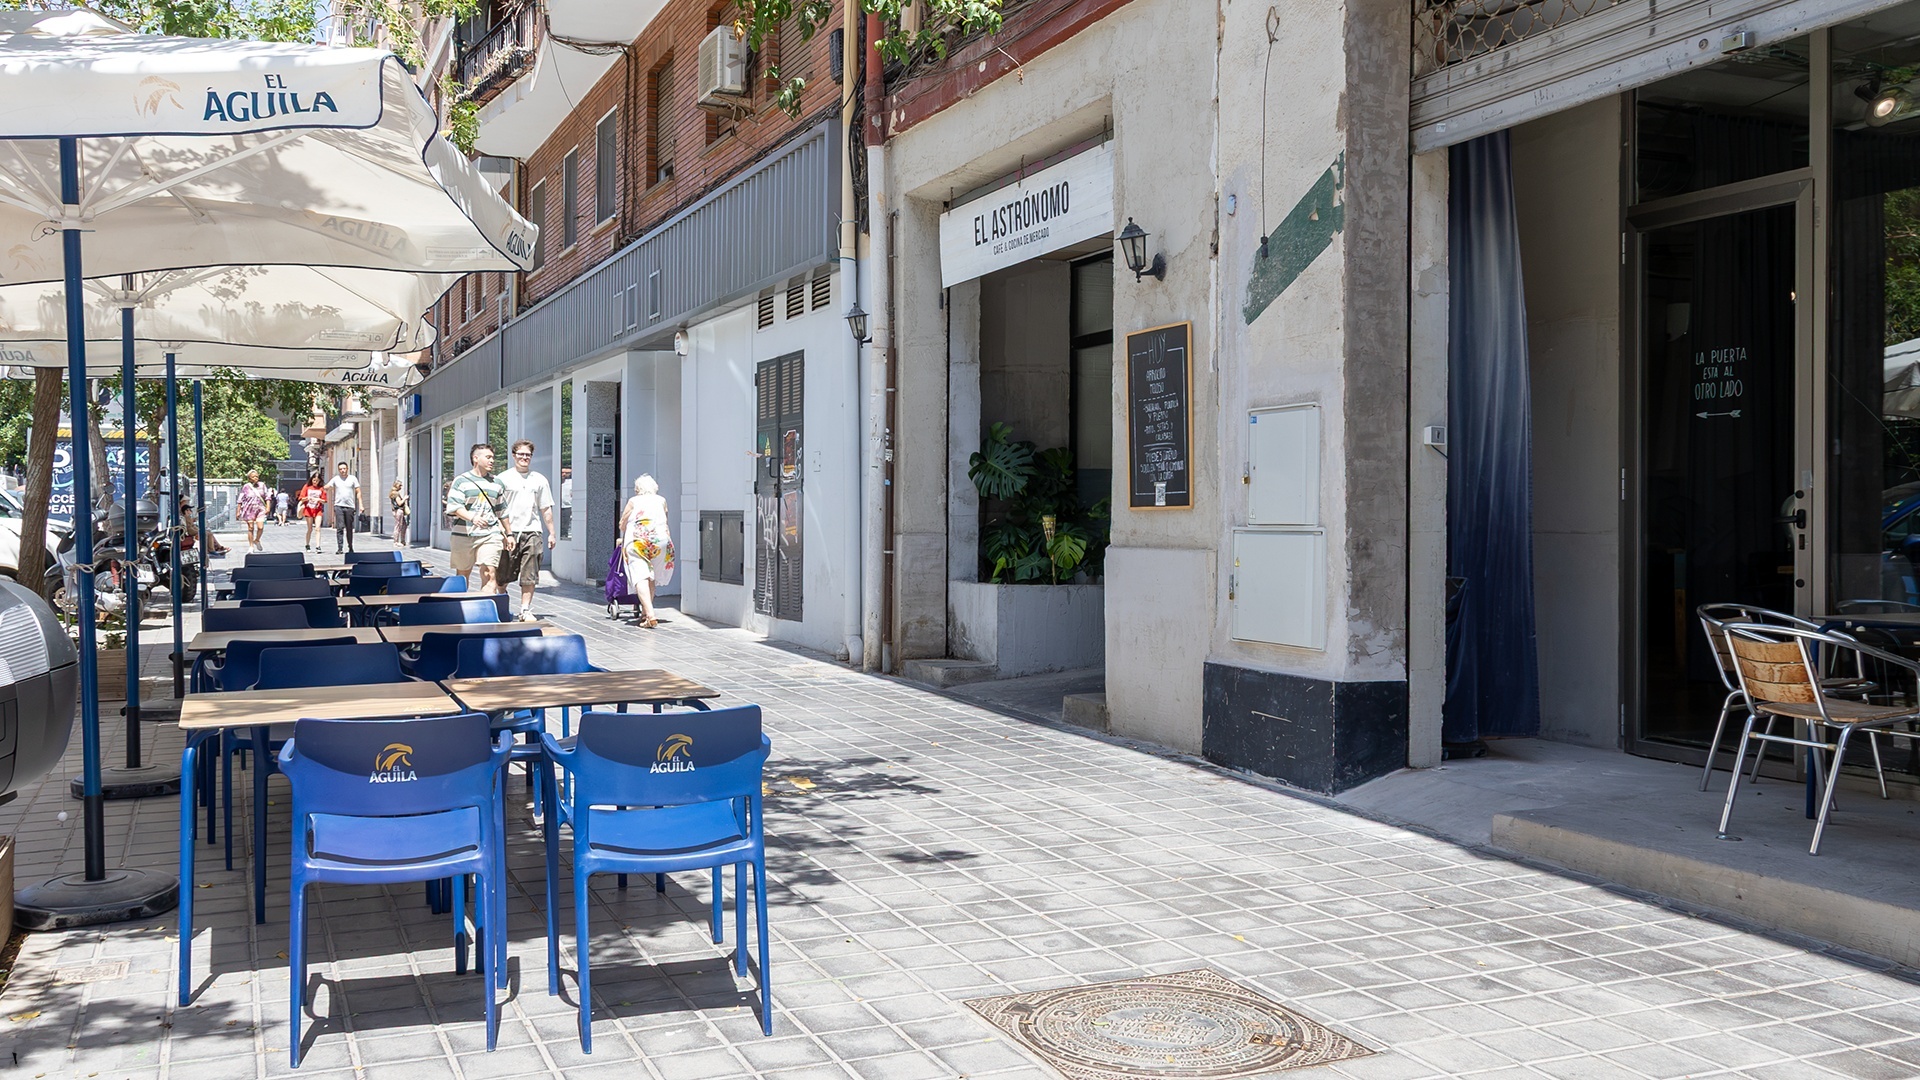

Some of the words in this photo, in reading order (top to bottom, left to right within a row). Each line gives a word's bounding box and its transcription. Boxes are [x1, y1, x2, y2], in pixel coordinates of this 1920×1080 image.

[264, 74, 288, 89] EL
[203, 86, 339, 122] ÁGUILA
[974, 214, 989, 247] EL
[991, 180, 1070, 241] ASTRÓNOMO
[1008, 236, 1023, 251] COCINA
[1023, 233, 1030, 246] DE
[1029, 226, 1050, 244] MERCADO
[1147, 333, 1166, 364] HOY
[1695, 351, 1705, 366] LA
[1711, 347, 1747, 364] PUERTA
[1723, 366, 1735, 377] AL
[1694, 382, 1717, 400] OTRO
[1719, 379, 1743, 398] LADO
[368, 770, 418, 784] ÁGUILA
[649, 760, 696, 774] ÁGUILA
